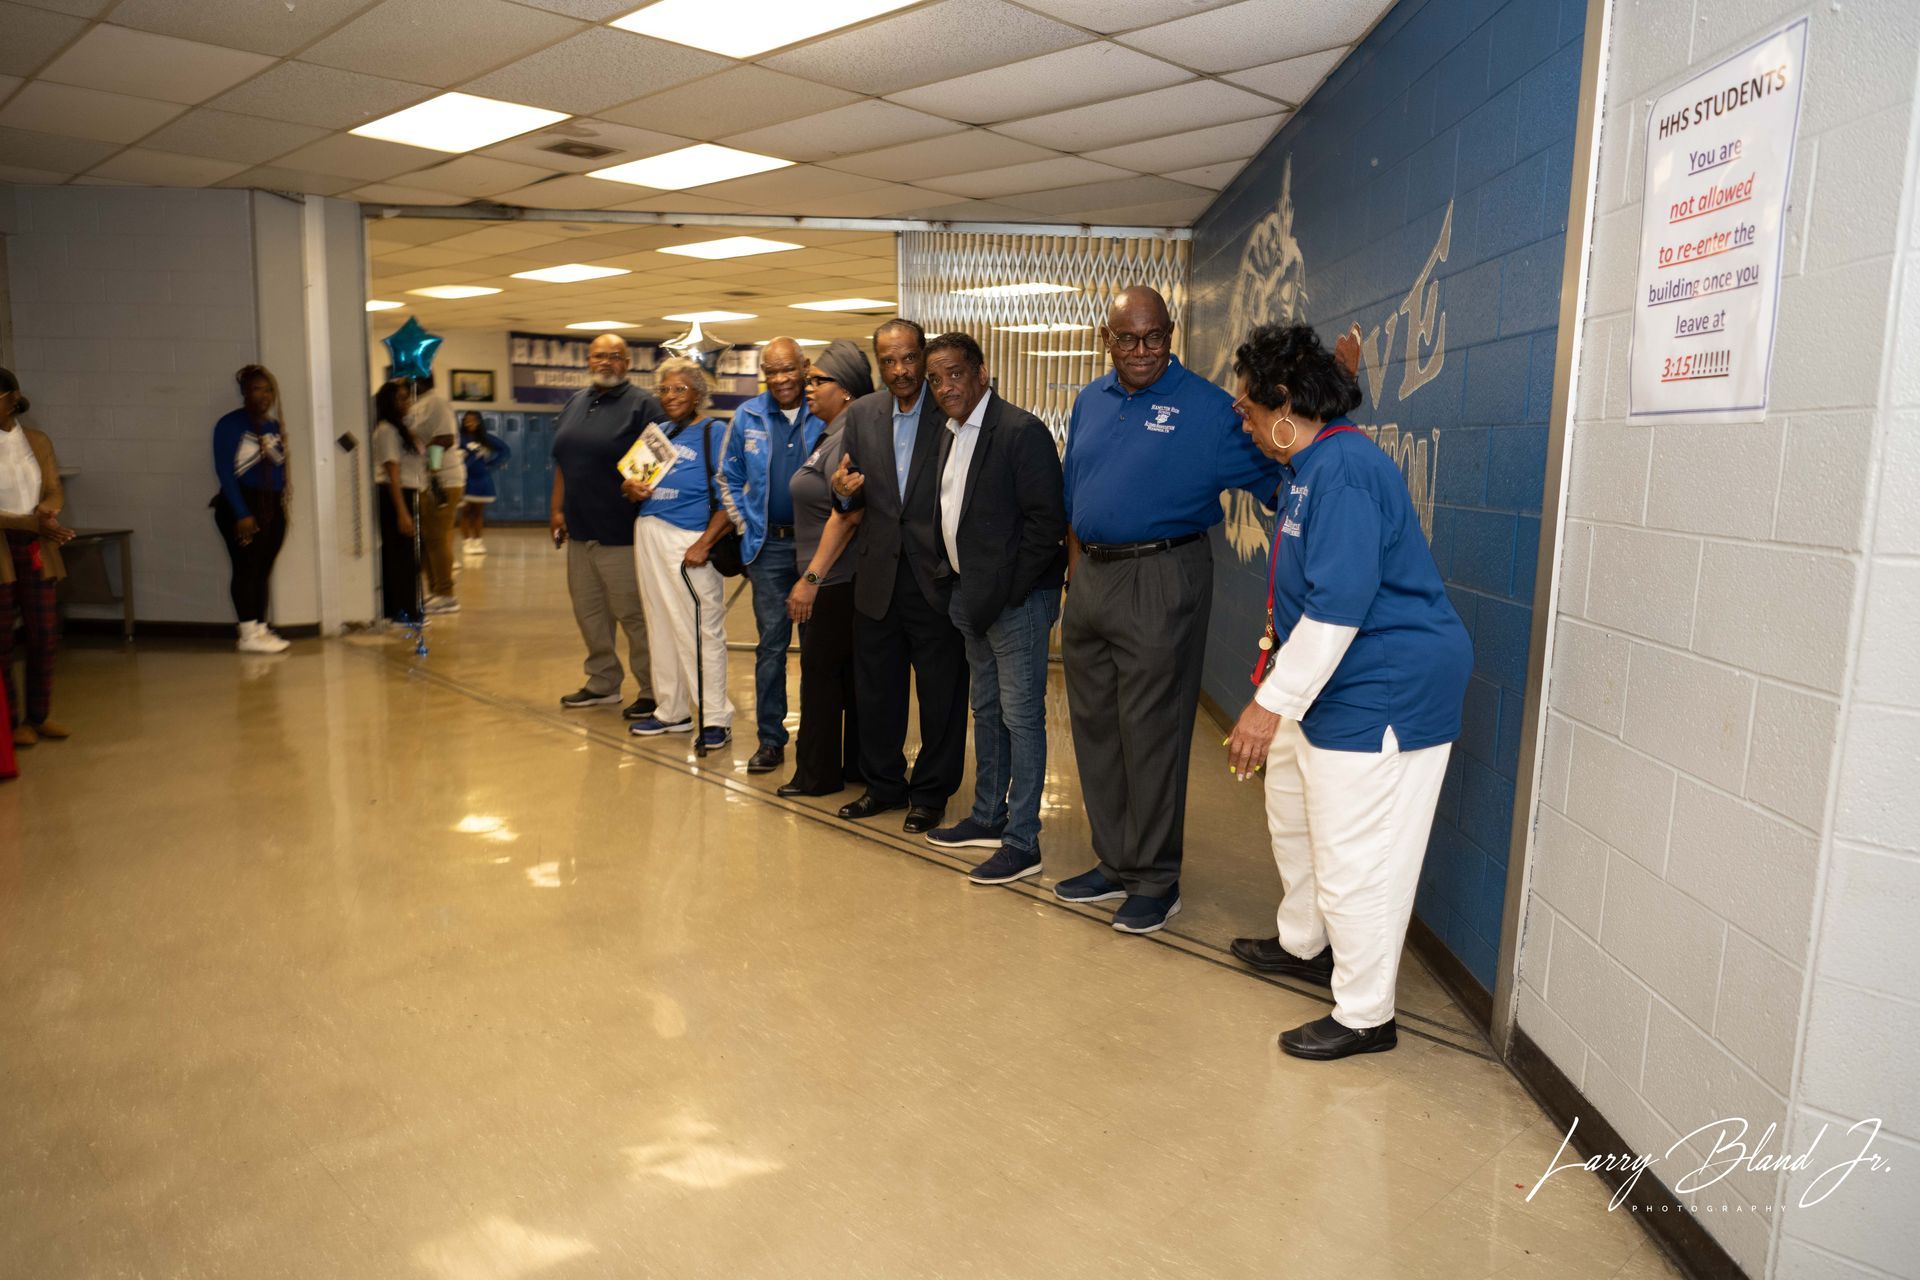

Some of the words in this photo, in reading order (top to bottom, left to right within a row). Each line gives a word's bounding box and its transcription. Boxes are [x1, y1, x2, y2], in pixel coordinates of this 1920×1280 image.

[1659, 107, 1690, 141] HHS
[1693, 64, 1787, 126] STUDENTS
[1689, 149, 1716, 171] You
[1719, 138, 1742, 161] are
[1669, 195, 1696, 220] not
[1697, 171, 1756, 212] allowed
[1658, 245, 1674, 265] to
[1676, 230, 1732, 261] re-enter
[1733, 221, 1756, 245] the
[1648, 277, 1701, 304] building
[1702, 271, 1733, 292] once
[1735, 263, 1760, 289] you
[1675, 314, 1710, 335] leave
[1712, 308, 1727, 329] at
